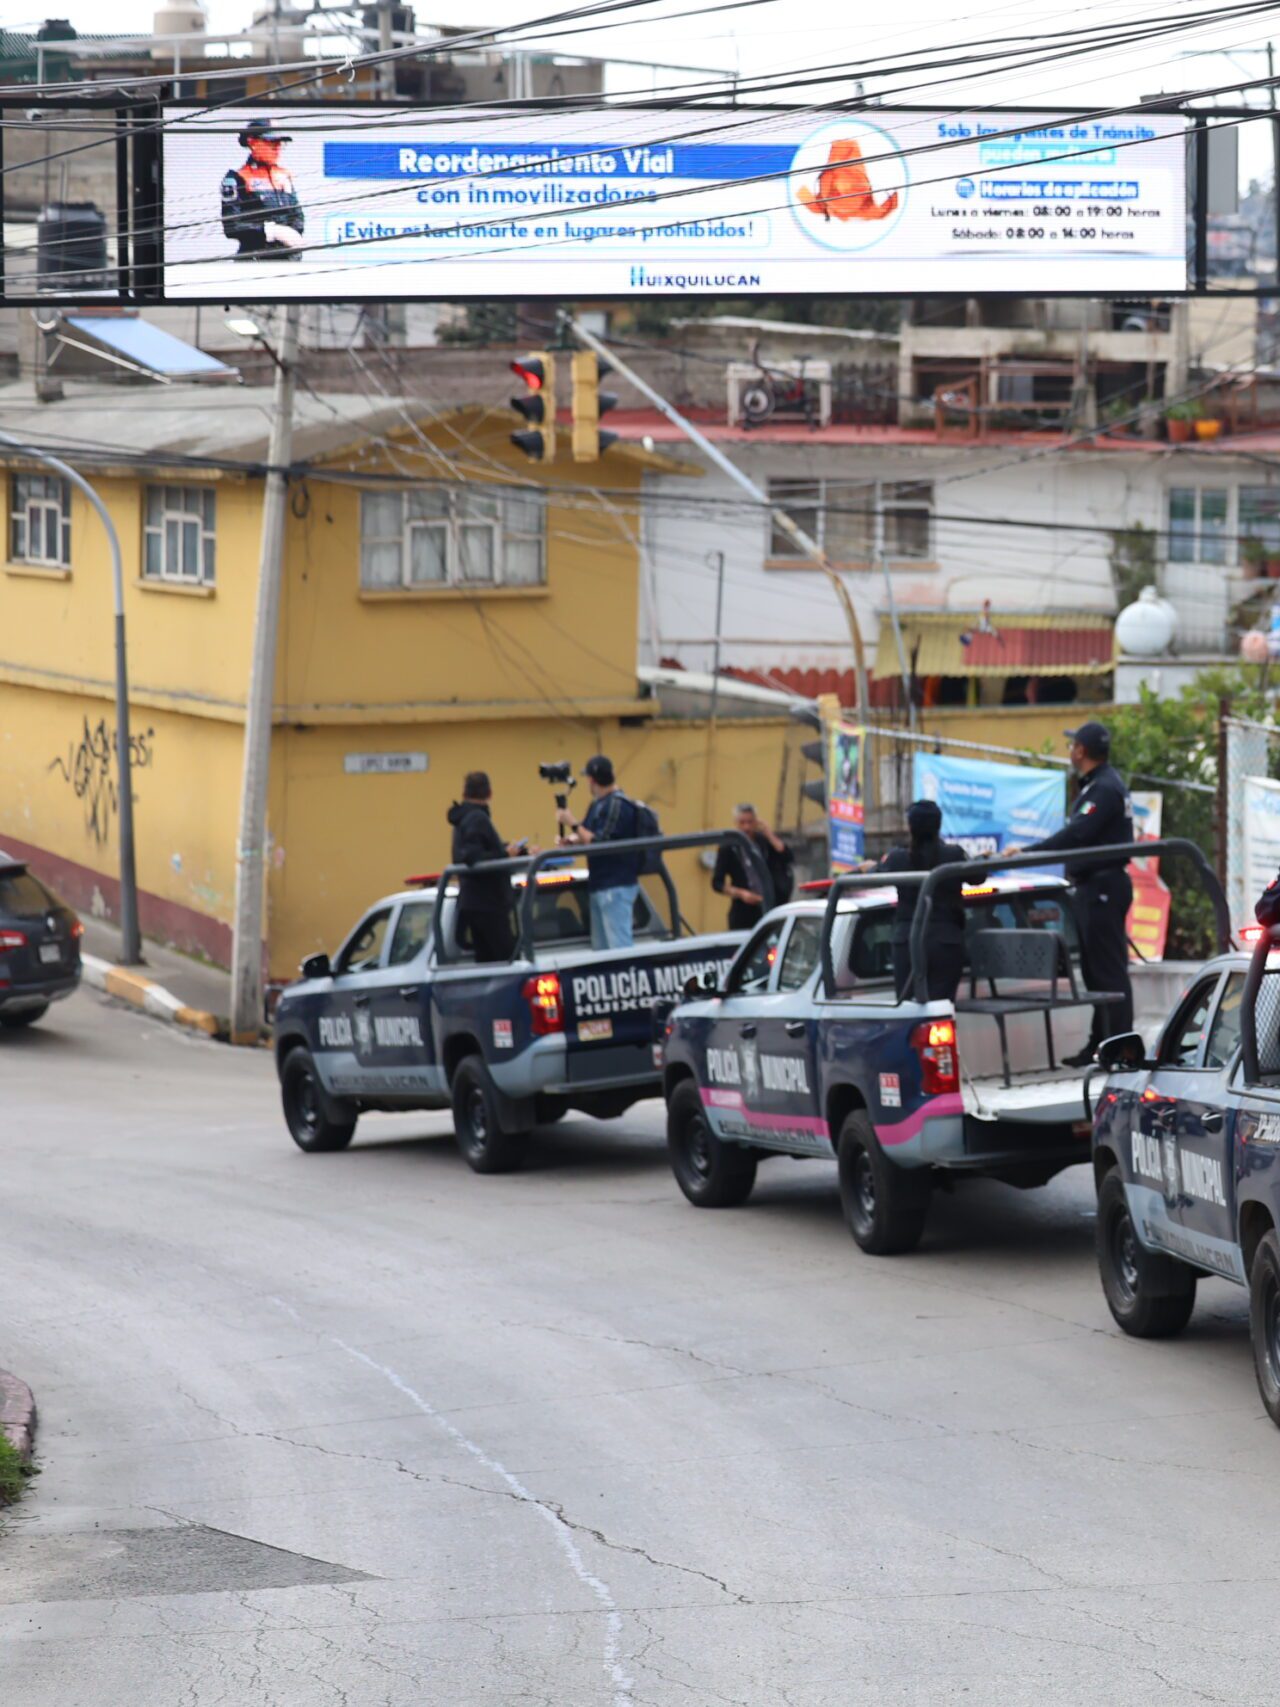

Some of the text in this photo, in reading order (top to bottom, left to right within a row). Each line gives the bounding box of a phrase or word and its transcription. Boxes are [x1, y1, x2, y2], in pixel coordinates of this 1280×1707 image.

[937, 123, 971, 138] Solo
[1069, 124, 1088, 139] de
[399, 147, 674, 174] Reordenamiento Vial
[416, 182, 658, 205] con inmovilizadores
[930, 206, 967, 218] Lunes
[1032, 206, 1071, 218] 08:00
[1087, 206, 1123, 218] 19:00
[1127, 206, 1161, 218] horas
[534, 225, 558, 238] en
[564, 221, 636, 243] lugares
[641, 220, 753, 243] prohibidos!
[1006, 227, 1045, 240] 08:00
[1101, 227, 1134, 240] horas
[572, 965, 652, 1005] POLICÍA
[1131, 1129, 1228, 1208] POLICÍA MUNICIPAL
